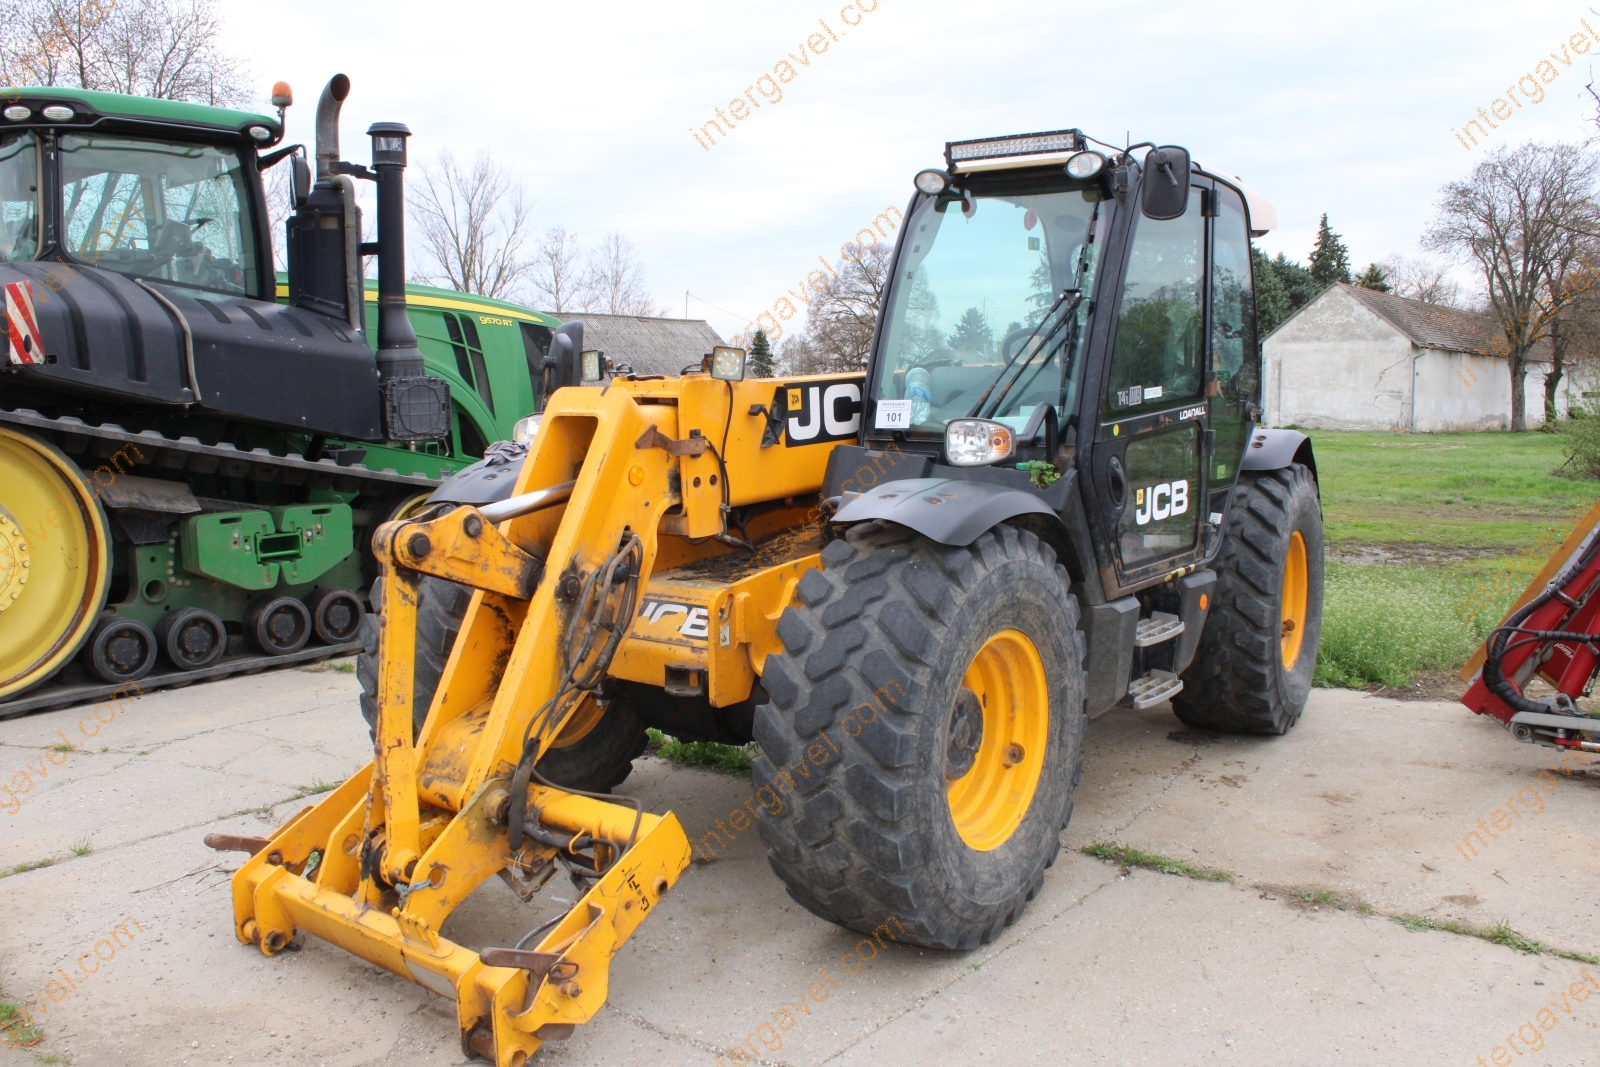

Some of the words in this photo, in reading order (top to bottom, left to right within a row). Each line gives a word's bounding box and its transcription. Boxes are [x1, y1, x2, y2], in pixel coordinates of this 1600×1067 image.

[479, 316, 502, 326] 9570
[502, 319, 513, 327] RT
[788, 383, 865, 441] JC
[886, 412, 902, 422] 101
[1136, 479, 1188, 525] JCB
